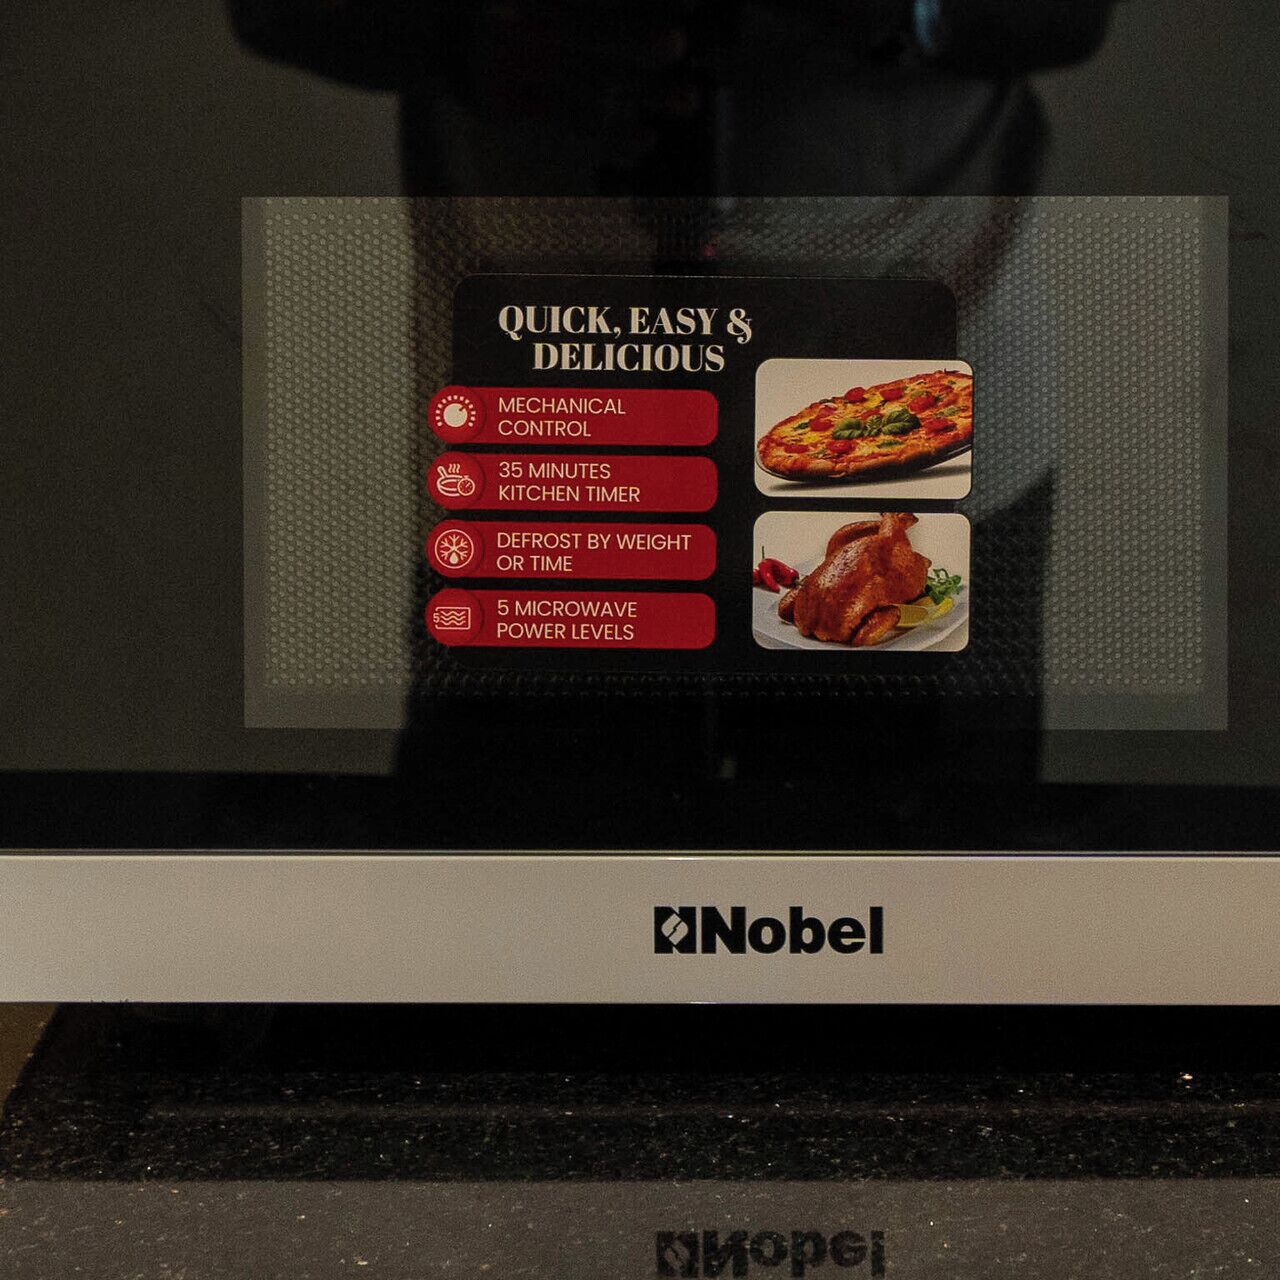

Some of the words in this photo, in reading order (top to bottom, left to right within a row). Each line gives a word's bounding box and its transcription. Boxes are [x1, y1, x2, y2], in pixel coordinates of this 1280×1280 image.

[498, 304, 621, 340] QUICK,
[630, 307, 718, 335] EASY
[726, 307, 753, 344] &
[532, 342, 725, 373] DELICIOUS
[498, 397, 625, 415] MECHANICAL
[498, 420, 591, 437] CONTROL
[499, 462, 523, 479] 35
[529, 462, 611, 480] MINUTES
[498, 485, 580, 502] KITCHEN
[586, 486, 640, 503] TIMER
[497, 532, 582, 550] DEFROST
[587, 533, 611, 550] BY
[616, 533, 692, 552] WEIGHT
[497, 554, 524, 571] OR
[529, 555, 572, 572] TIME
[432, 612, 440, 623] 5
[497, 599, 509, 616] 5
[515, 600, 637, 618] MICROWAVE
[497, 622, 566, 640] POWER
[571, 623, 634, 641] LEVELS
[701, 906, 883, 954] Nobel
